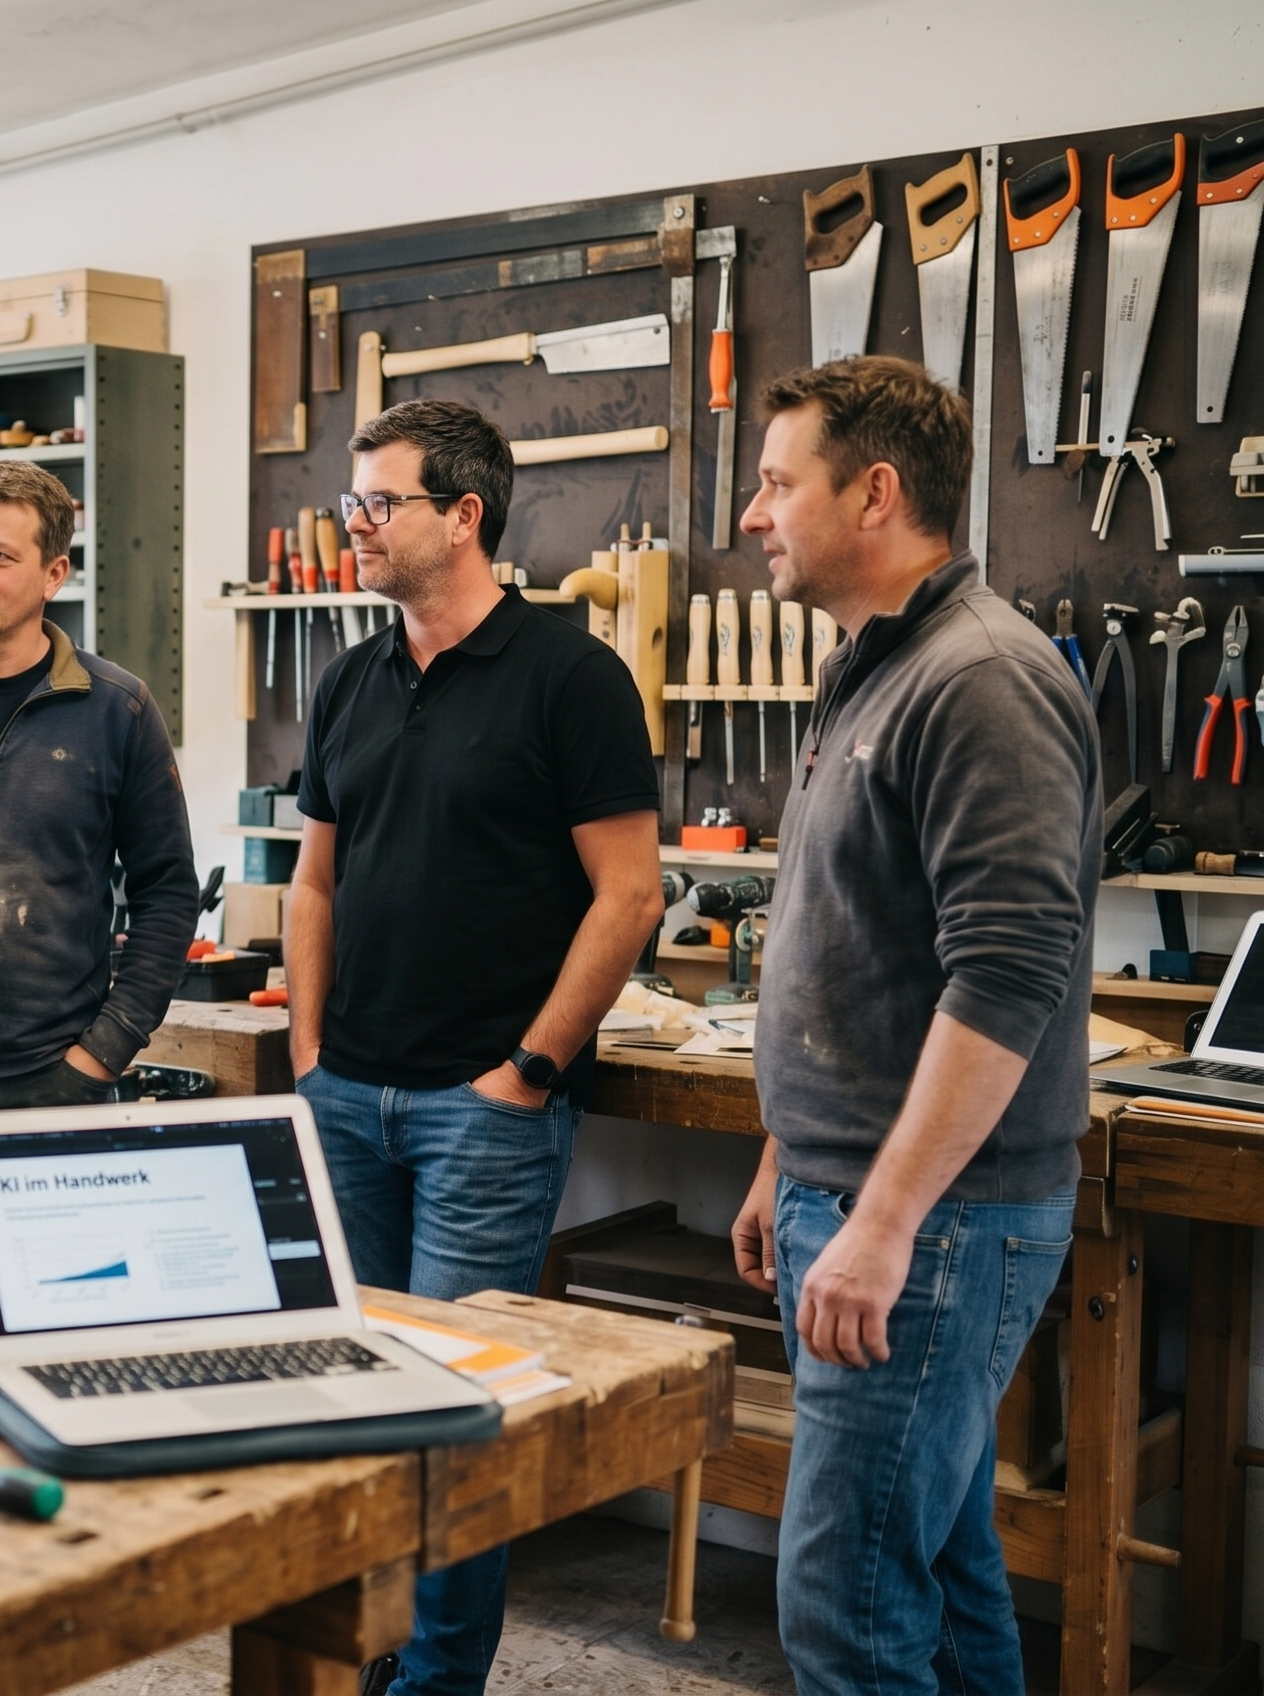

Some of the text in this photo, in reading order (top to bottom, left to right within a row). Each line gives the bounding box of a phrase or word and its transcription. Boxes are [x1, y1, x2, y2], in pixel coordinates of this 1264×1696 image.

[0, 1169, 150, 1192] KI im Handwerk
